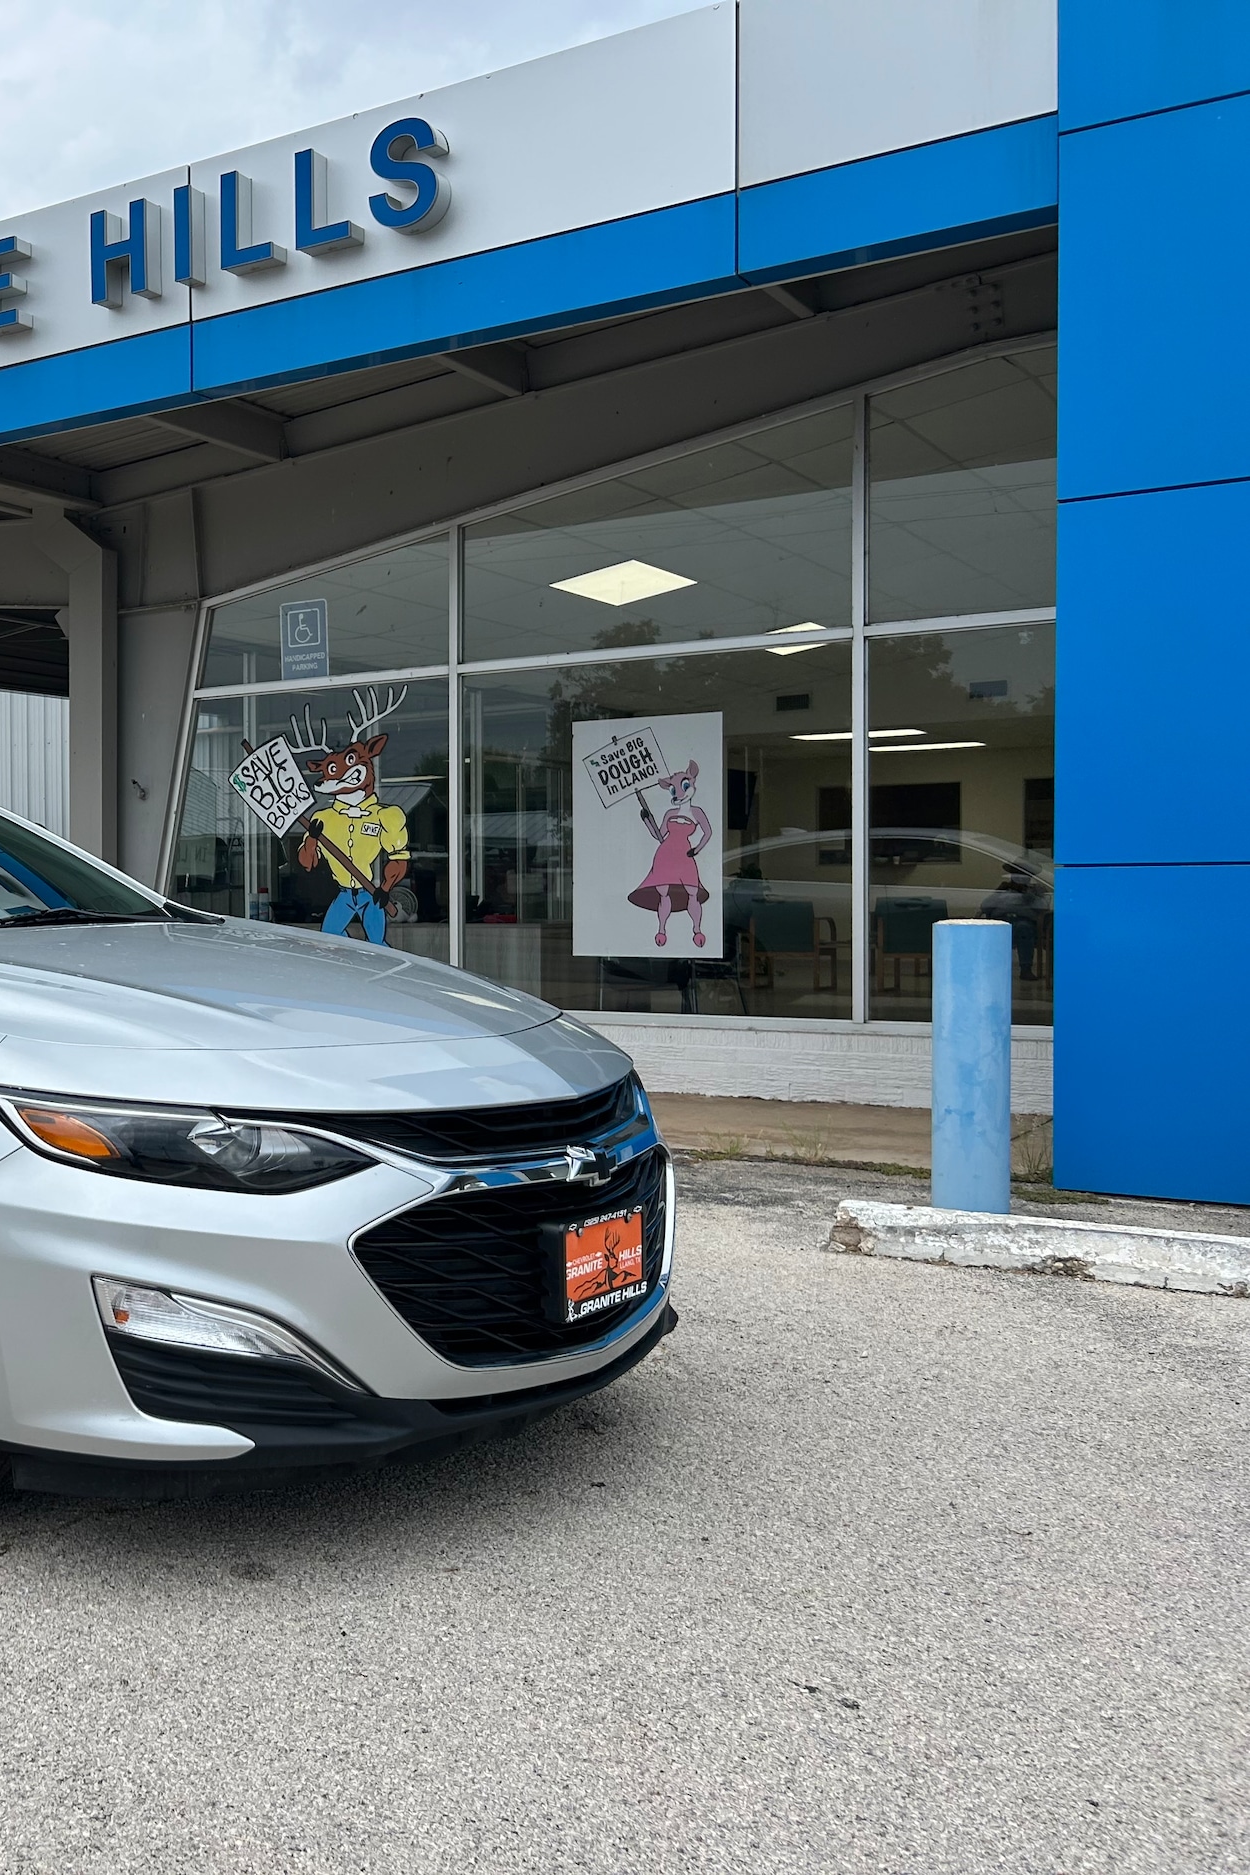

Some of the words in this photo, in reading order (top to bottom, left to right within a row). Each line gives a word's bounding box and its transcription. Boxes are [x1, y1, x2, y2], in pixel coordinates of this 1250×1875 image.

[90, 116, 452, 309] HILLS
[284, 651, 326, 663] HANDICAPPED
[291, 662, 319, 671] PARKING
[597, 747, 654, 786] DOUGH
[600, 748, 626, 765] Save
[625, 737, 644, 753] BIG
[250, 766, 295, 810] BIG
[606, 784, 619, 796] in
[618, 763, 659, 790] LLANO!
[267, 783, 310, 830] BUCKS
[618, 1244, 642, 1262] HILLS
[580, 1290, 621, 1315] GRANITE
[622, 1281, 647, 1300] HILLS
